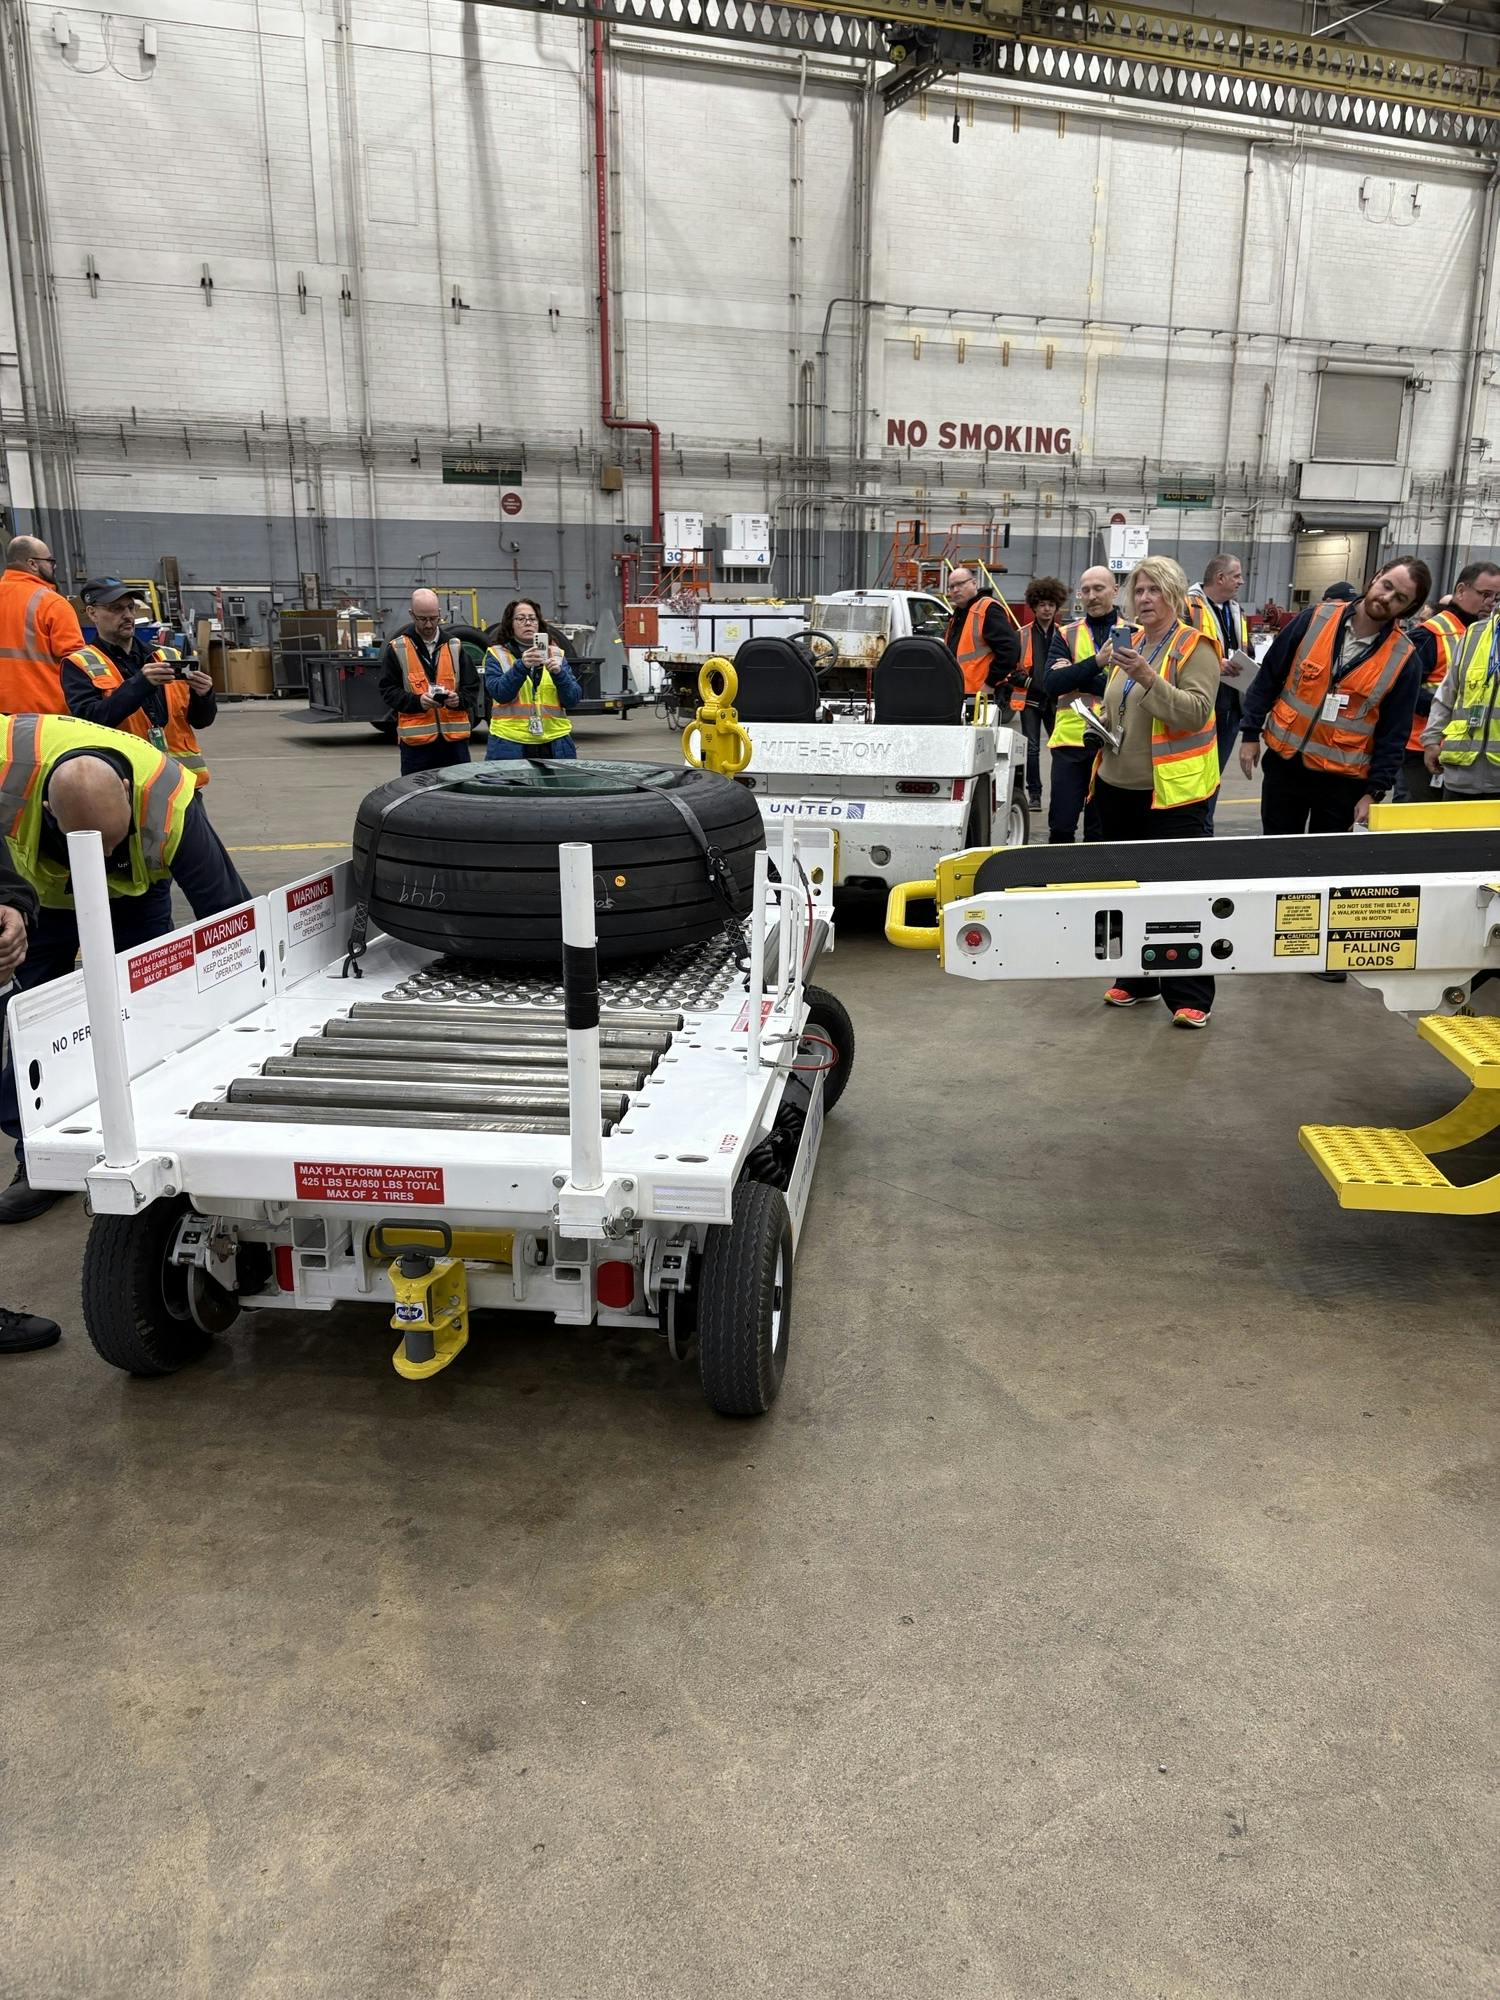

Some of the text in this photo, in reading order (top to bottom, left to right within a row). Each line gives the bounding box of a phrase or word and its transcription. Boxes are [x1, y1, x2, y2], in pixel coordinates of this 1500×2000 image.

[887, 419, 1071, 454] NO SMOKING
[757, 553, 765, 563] 4
[1110, 560, 1123, 569] 3B
[770, 803, 842, 816] UNITED
[293, 881, 328, 906] WARNING
[1350, 888, 1399, 897] WARNING
[203, 915, 248, 946] WARNING
[1344, 930, 1401, 939] ATTENTION
[131, 938, 191, 969] MAX PLATFORM CAPACITY
[212, 939, 242, 959] PINCH POINT
[1343, 942, 1400, 953] FALLING
[132, 969, 141, 978] 425
[141, 965, 151, 975] LBS
[168, 954, 177, 963] LBS
[178, 948, 192, 959] TOTAL
[203, 945, 252, 974] KEEP CLEAR DURING
[1348, 956, 1394, 966] LOADS
[144, 973, 155, 984] MAX
[155, 970, 162, 979] OF
[169, 962, 182, 973] TIRES
[215, 961, 243, 979] OPERATION
[52, 1036, 68, 1054] NO
[300, 1166, 439, 1179] MAX PLATFORM CAPACITY
[302, 1177, 440, 1191] 425 LBS EA/850 LBS TOTAL
[327, 1189, 414, 1201] MAX OF 2 TIRES
